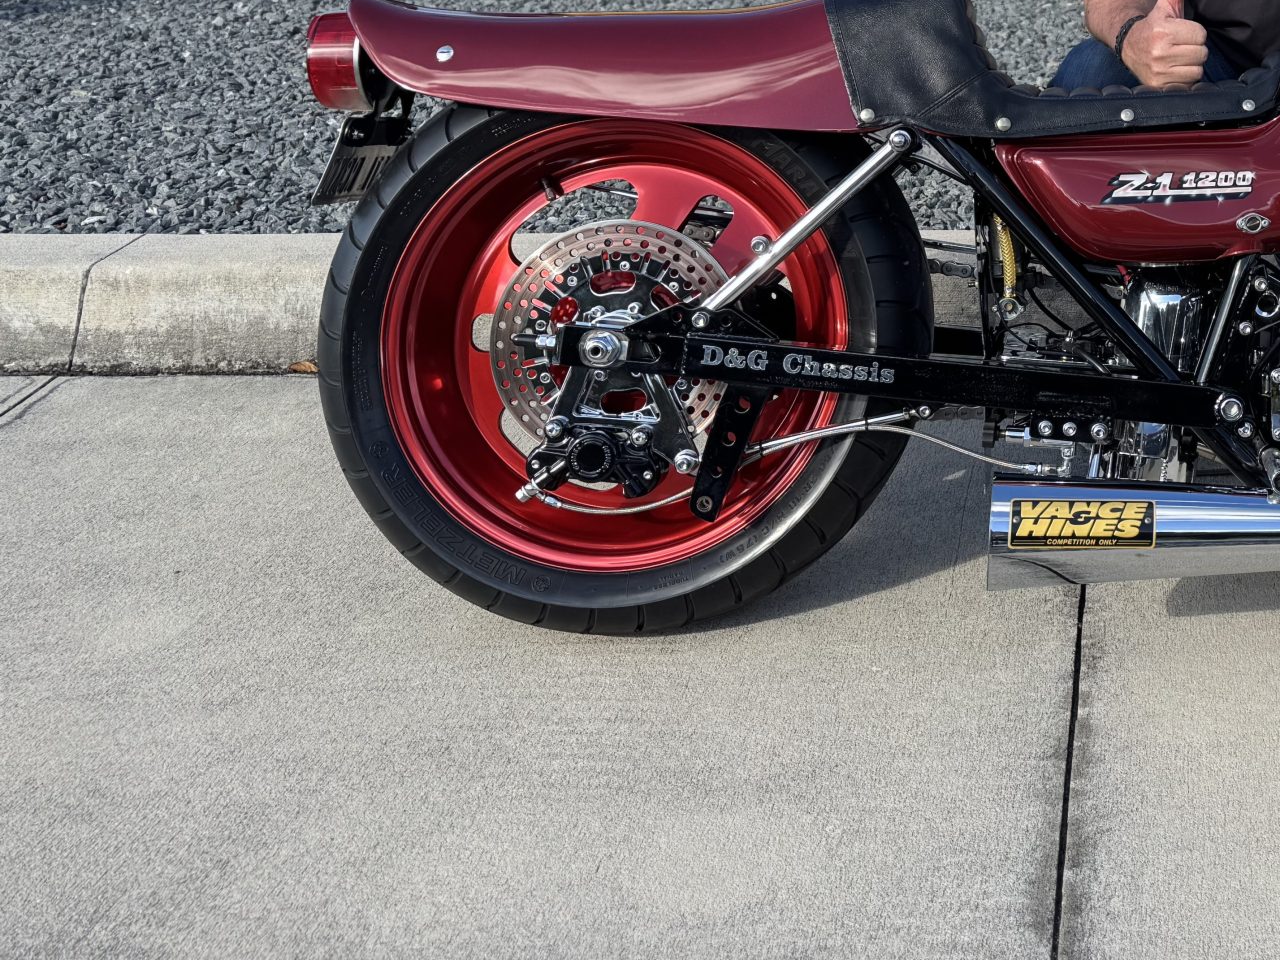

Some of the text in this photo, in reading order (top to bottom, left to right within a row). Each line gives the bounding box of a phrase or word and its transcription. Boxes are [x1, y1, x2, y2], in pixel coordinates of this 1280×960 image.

[1111, 170, 1253, 198] Z-1 1200
[700, 344, 769, 371] D&G
[783, 353, 895, 384] Chassis
[1020, 501, 1149, 520] VANCE
[381, 462, 528, 586] METZELER
[1015, 518, 1142, 539] HINES
[1046, 538, 1118, 546] COMPETITION ONLY
